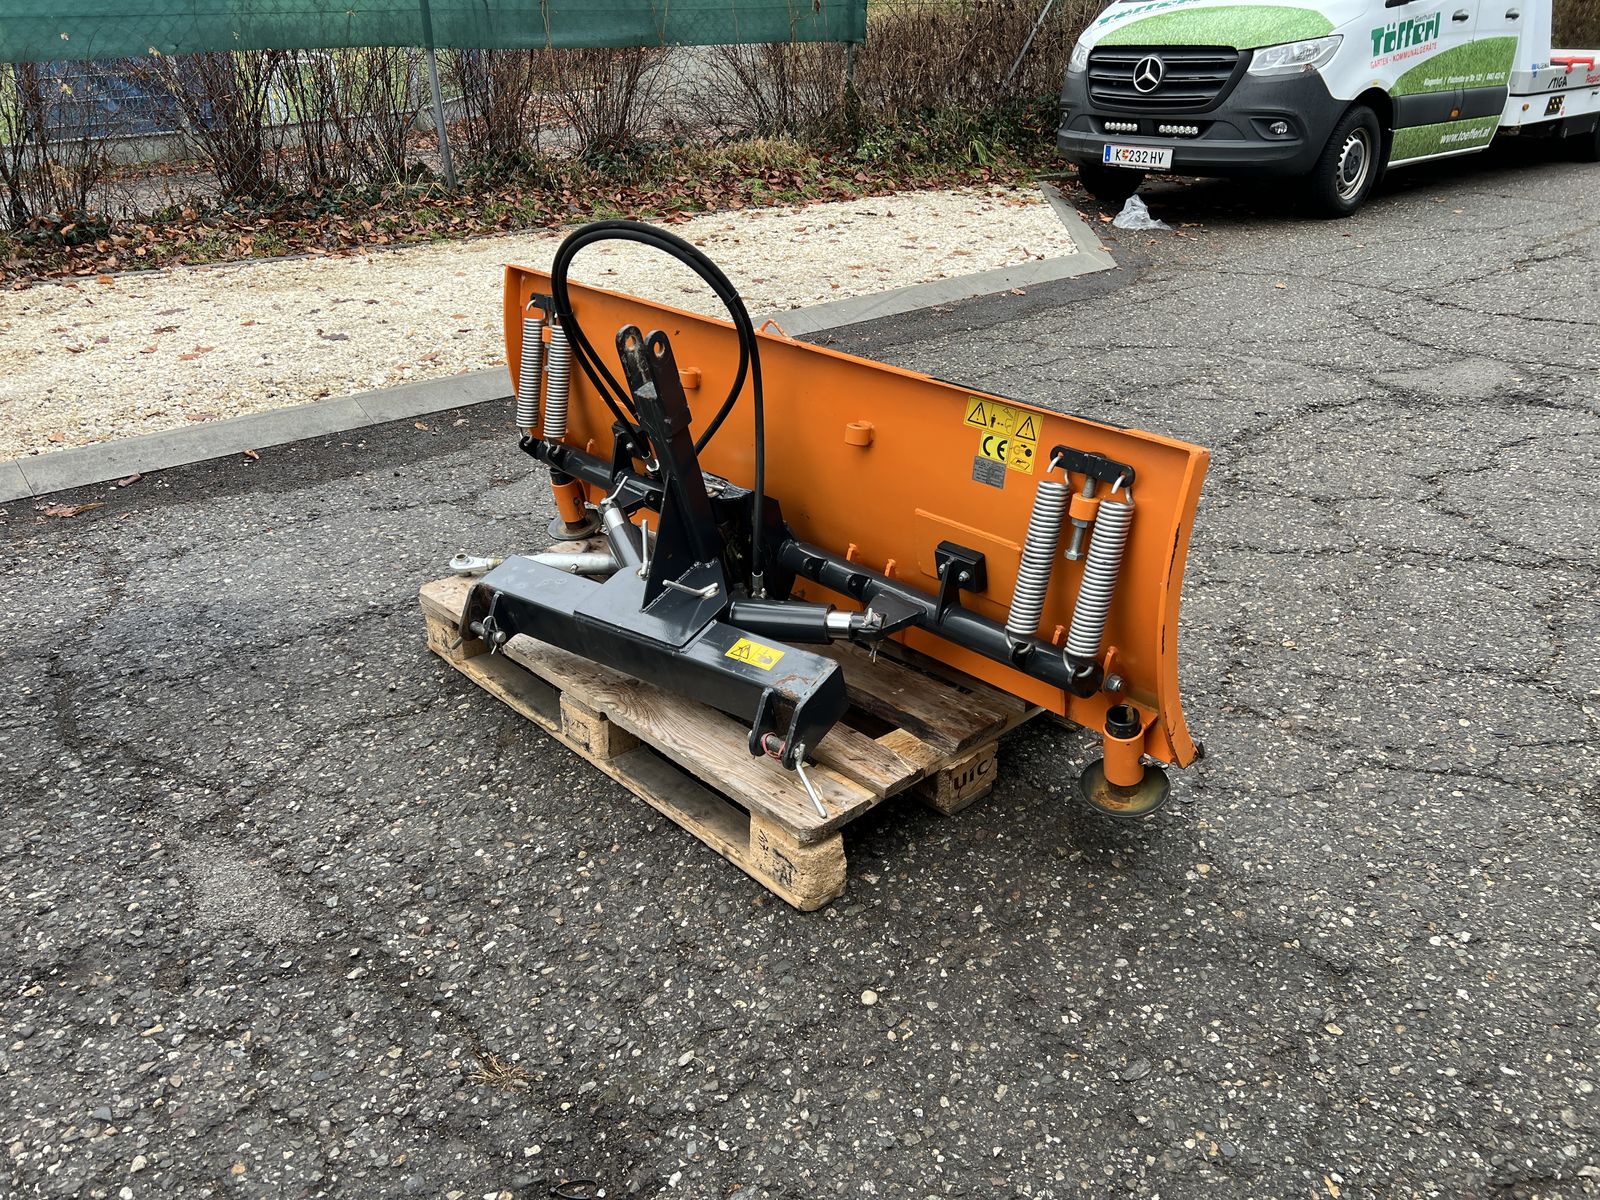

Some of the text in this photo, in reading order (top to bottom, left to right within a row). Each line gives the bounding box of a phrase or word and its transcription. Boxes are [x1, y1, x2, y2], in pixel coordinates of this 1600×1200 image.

[1371, 12, 1441, 57] Töfferl
[1370, 57, 1389, 69] GARTEN
[1440, 127, 1491, 144] www.toefferl.at
[1115, 148, 1165, 164] K 232 HV
[982, 435, 1008, 461] CE
